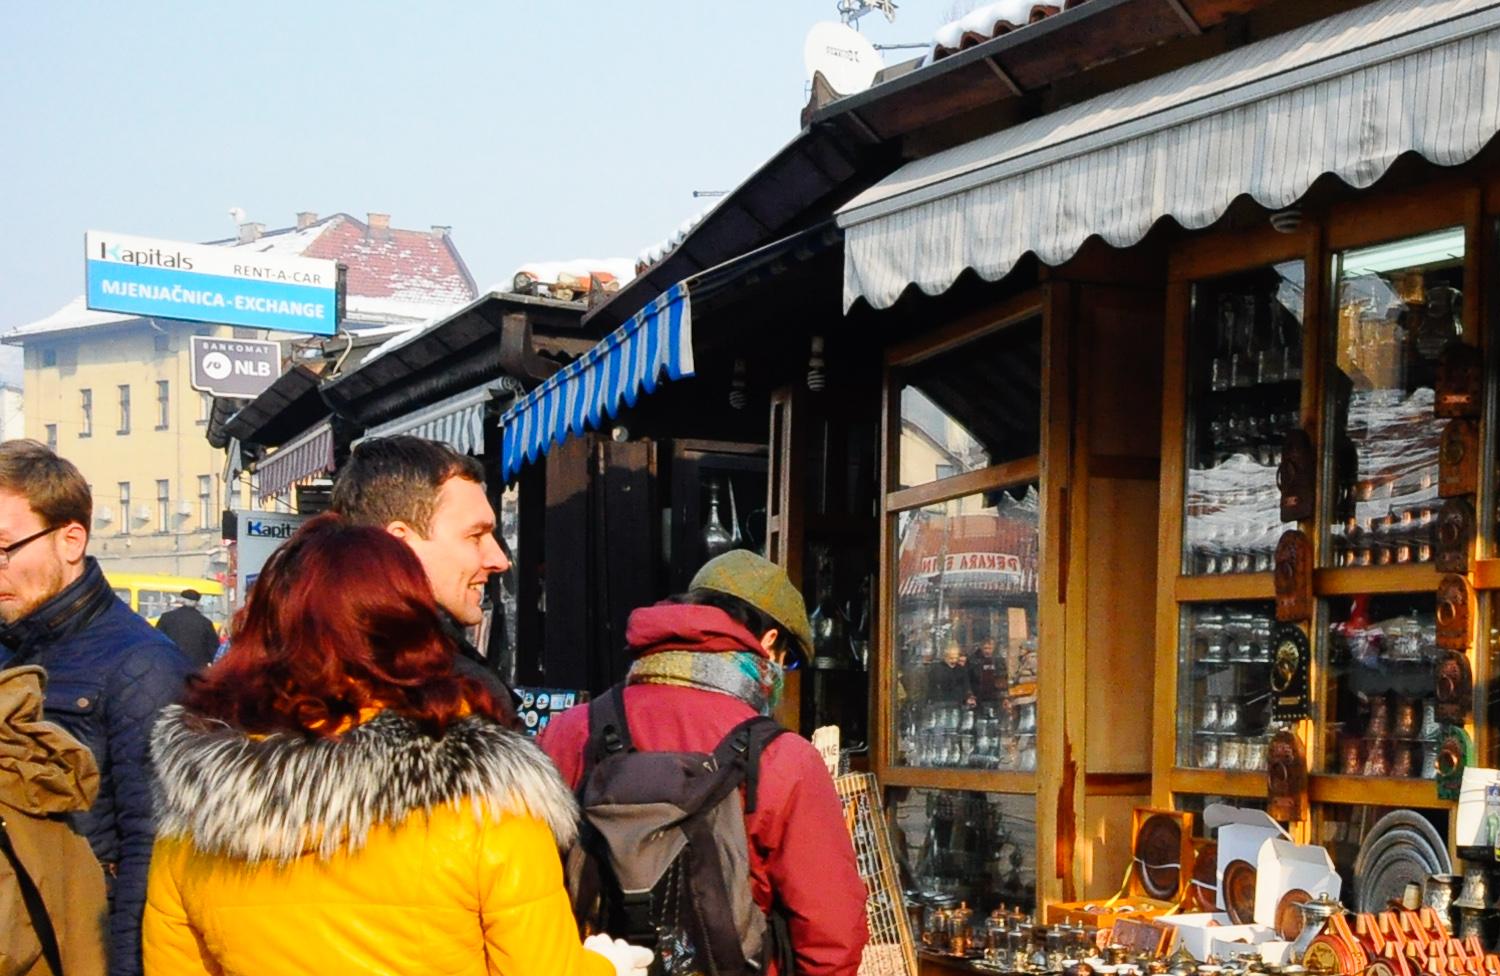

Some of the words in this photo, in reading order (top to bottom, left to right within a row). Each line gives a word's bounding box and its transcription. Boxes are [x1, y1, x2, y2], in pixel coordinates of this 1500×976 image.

[100, 241, 193, 270] Kapitals
[233, 264, 322, 285] RENT-A-CAR
[202, 342, 269, 354] BANKOMAT
[234, 359, 271, 377] NLB
